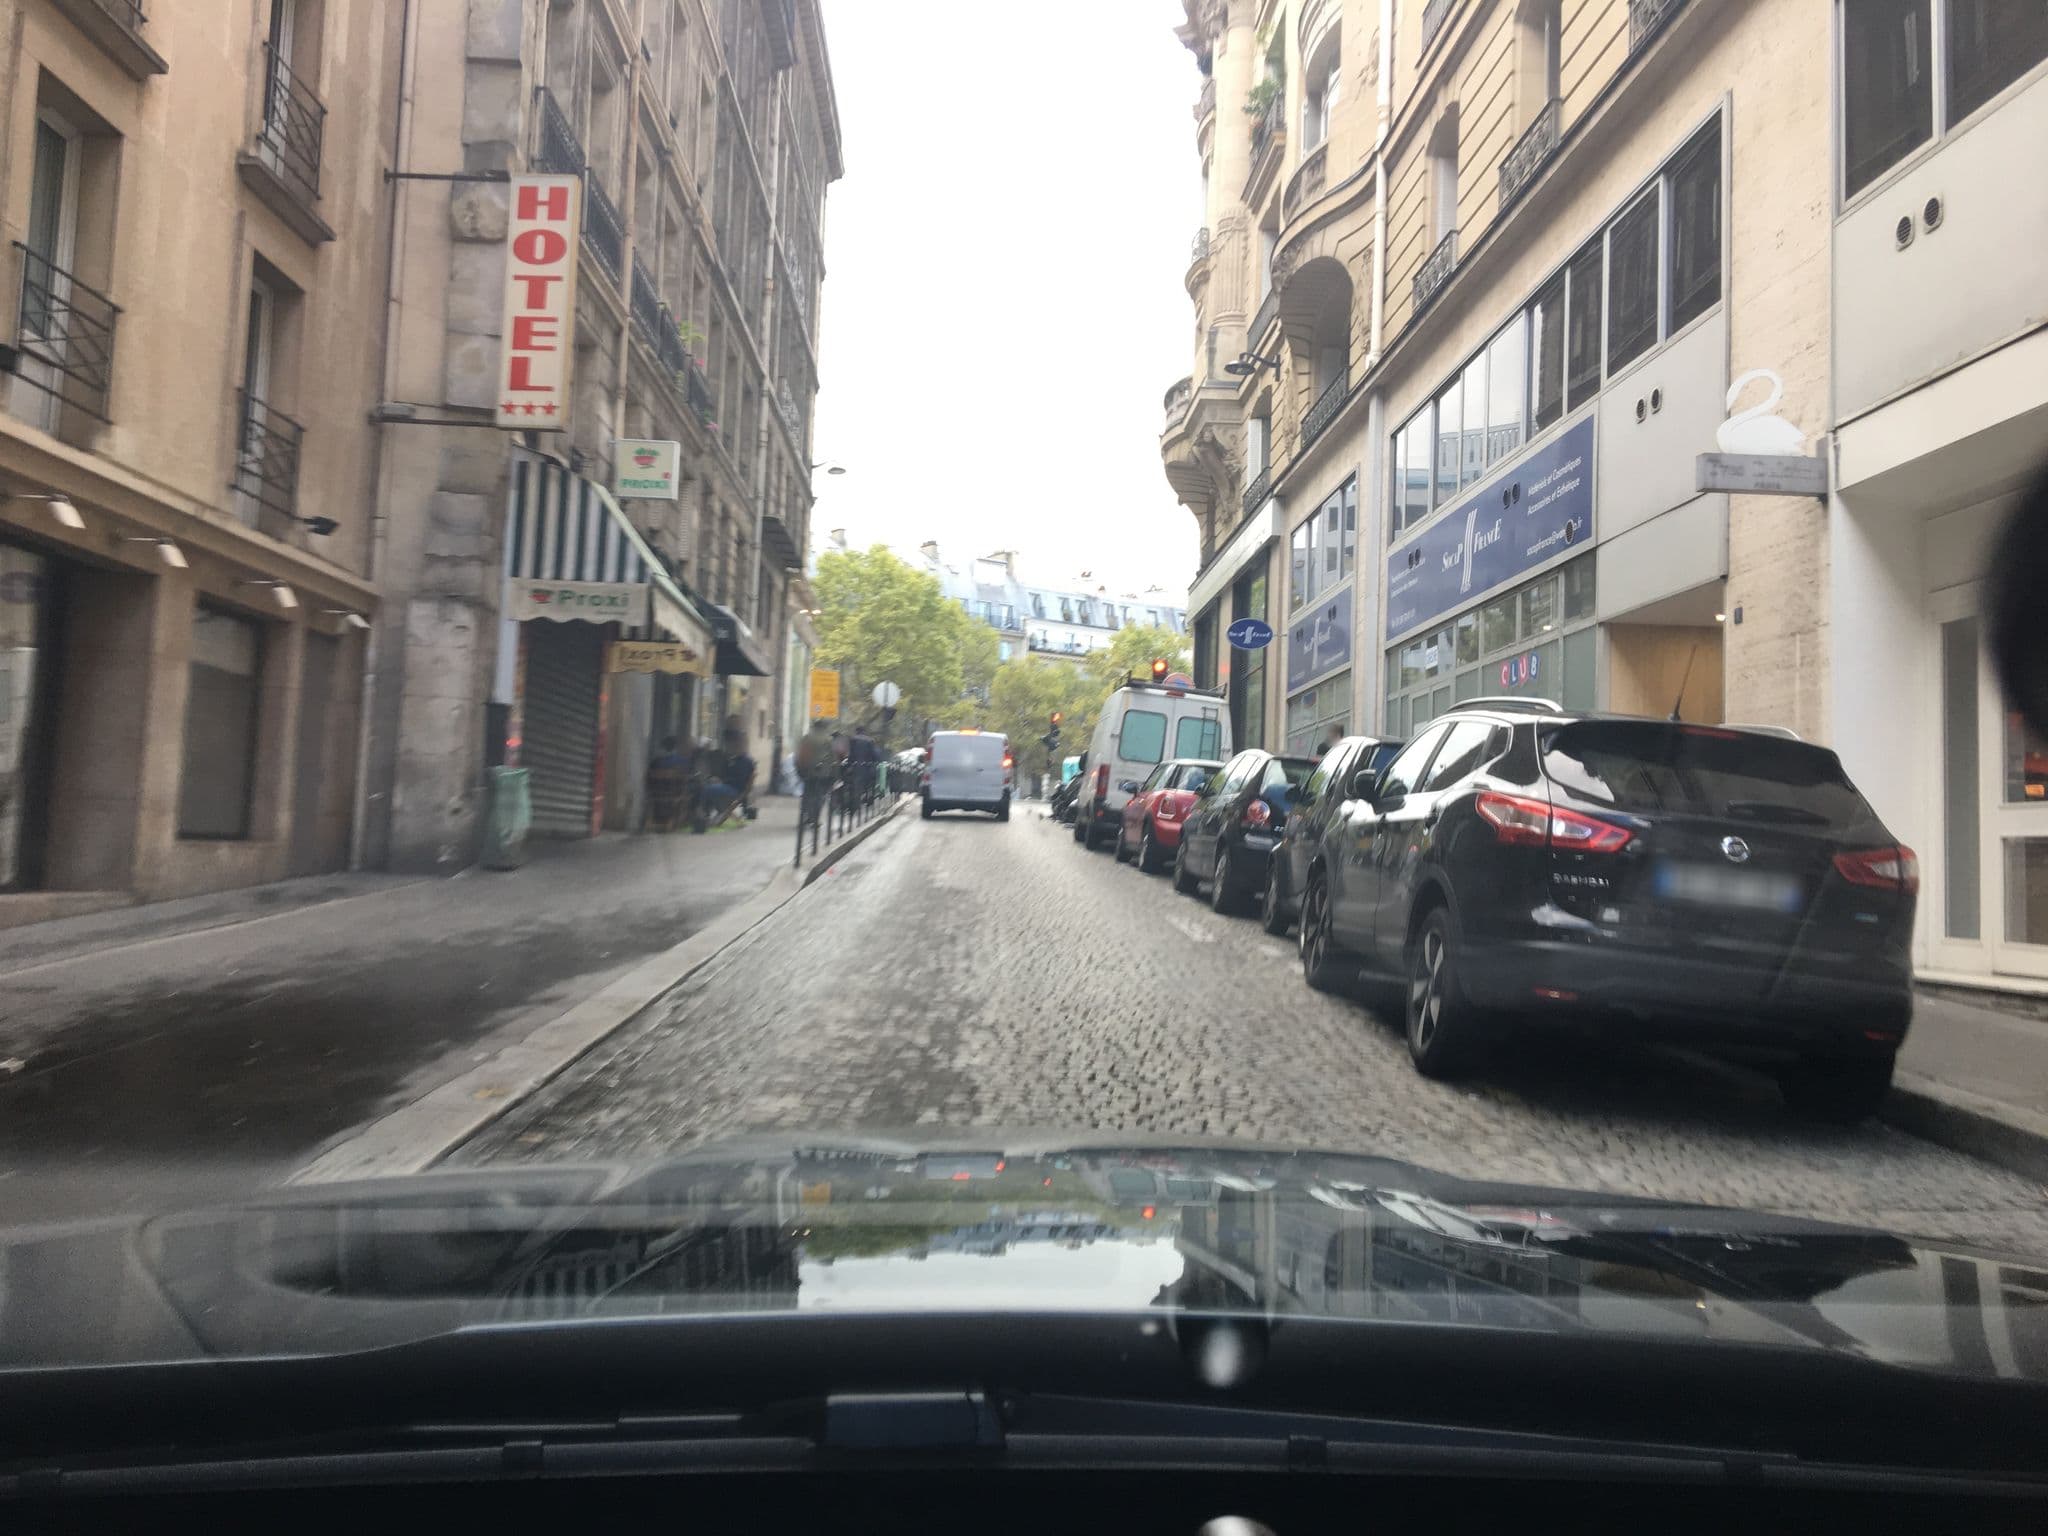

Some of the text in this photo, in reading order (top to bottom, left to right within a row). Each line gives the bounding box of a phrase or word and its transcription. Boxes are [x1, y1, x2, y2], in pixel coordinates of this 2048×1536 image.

[508, 186, 568, 391] HOTEL
[558, 589, 630, 607] Proxi
[1501, 654, 1539, 687] CLUB
